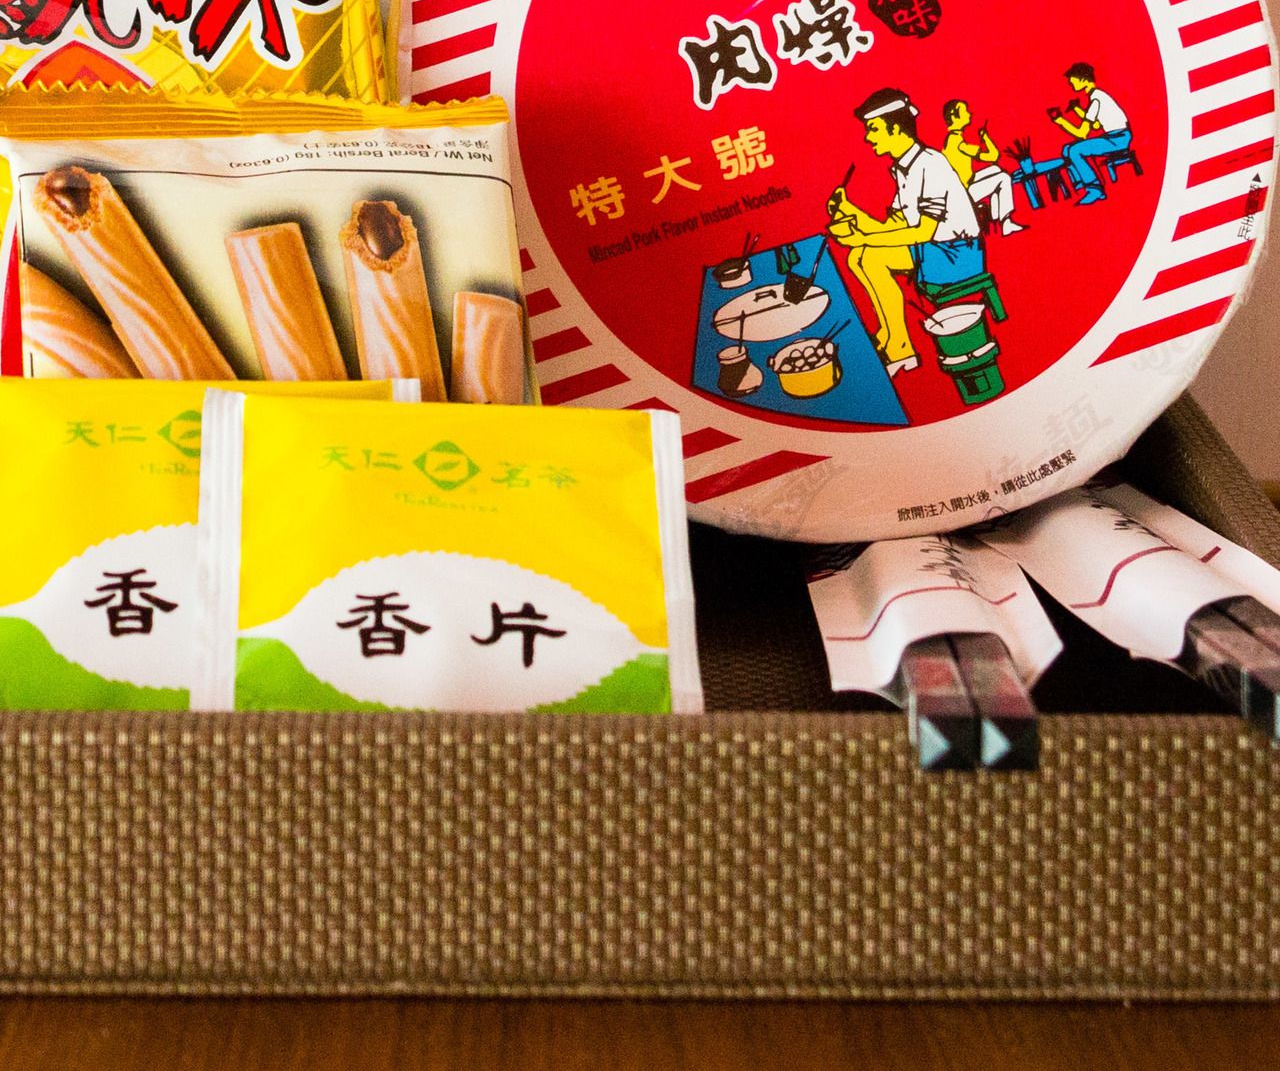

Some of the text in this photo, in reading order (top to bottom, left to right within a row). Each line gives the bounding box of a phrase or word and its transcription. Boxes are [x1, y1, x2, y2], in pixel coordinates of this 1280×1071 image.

[228, 154, 291, 169] (0.63oz)
[294, 151, 321, 160] 18g
[468, 151, 493, 163] Net
[569, 125, 775, 227] 特大號
[632, 229, 662, 250] Pork
[661, 216, 700, 240] Flavor
[700, 200, 742, 226] Instant
[741, 184, 793, 212] Noodles
[64, 419, 148, 448] 天仁
[319, 444, 404, 472] 天仁
[83, 568, 179, 637] 香
[336, 591, 568, 669] 香片
